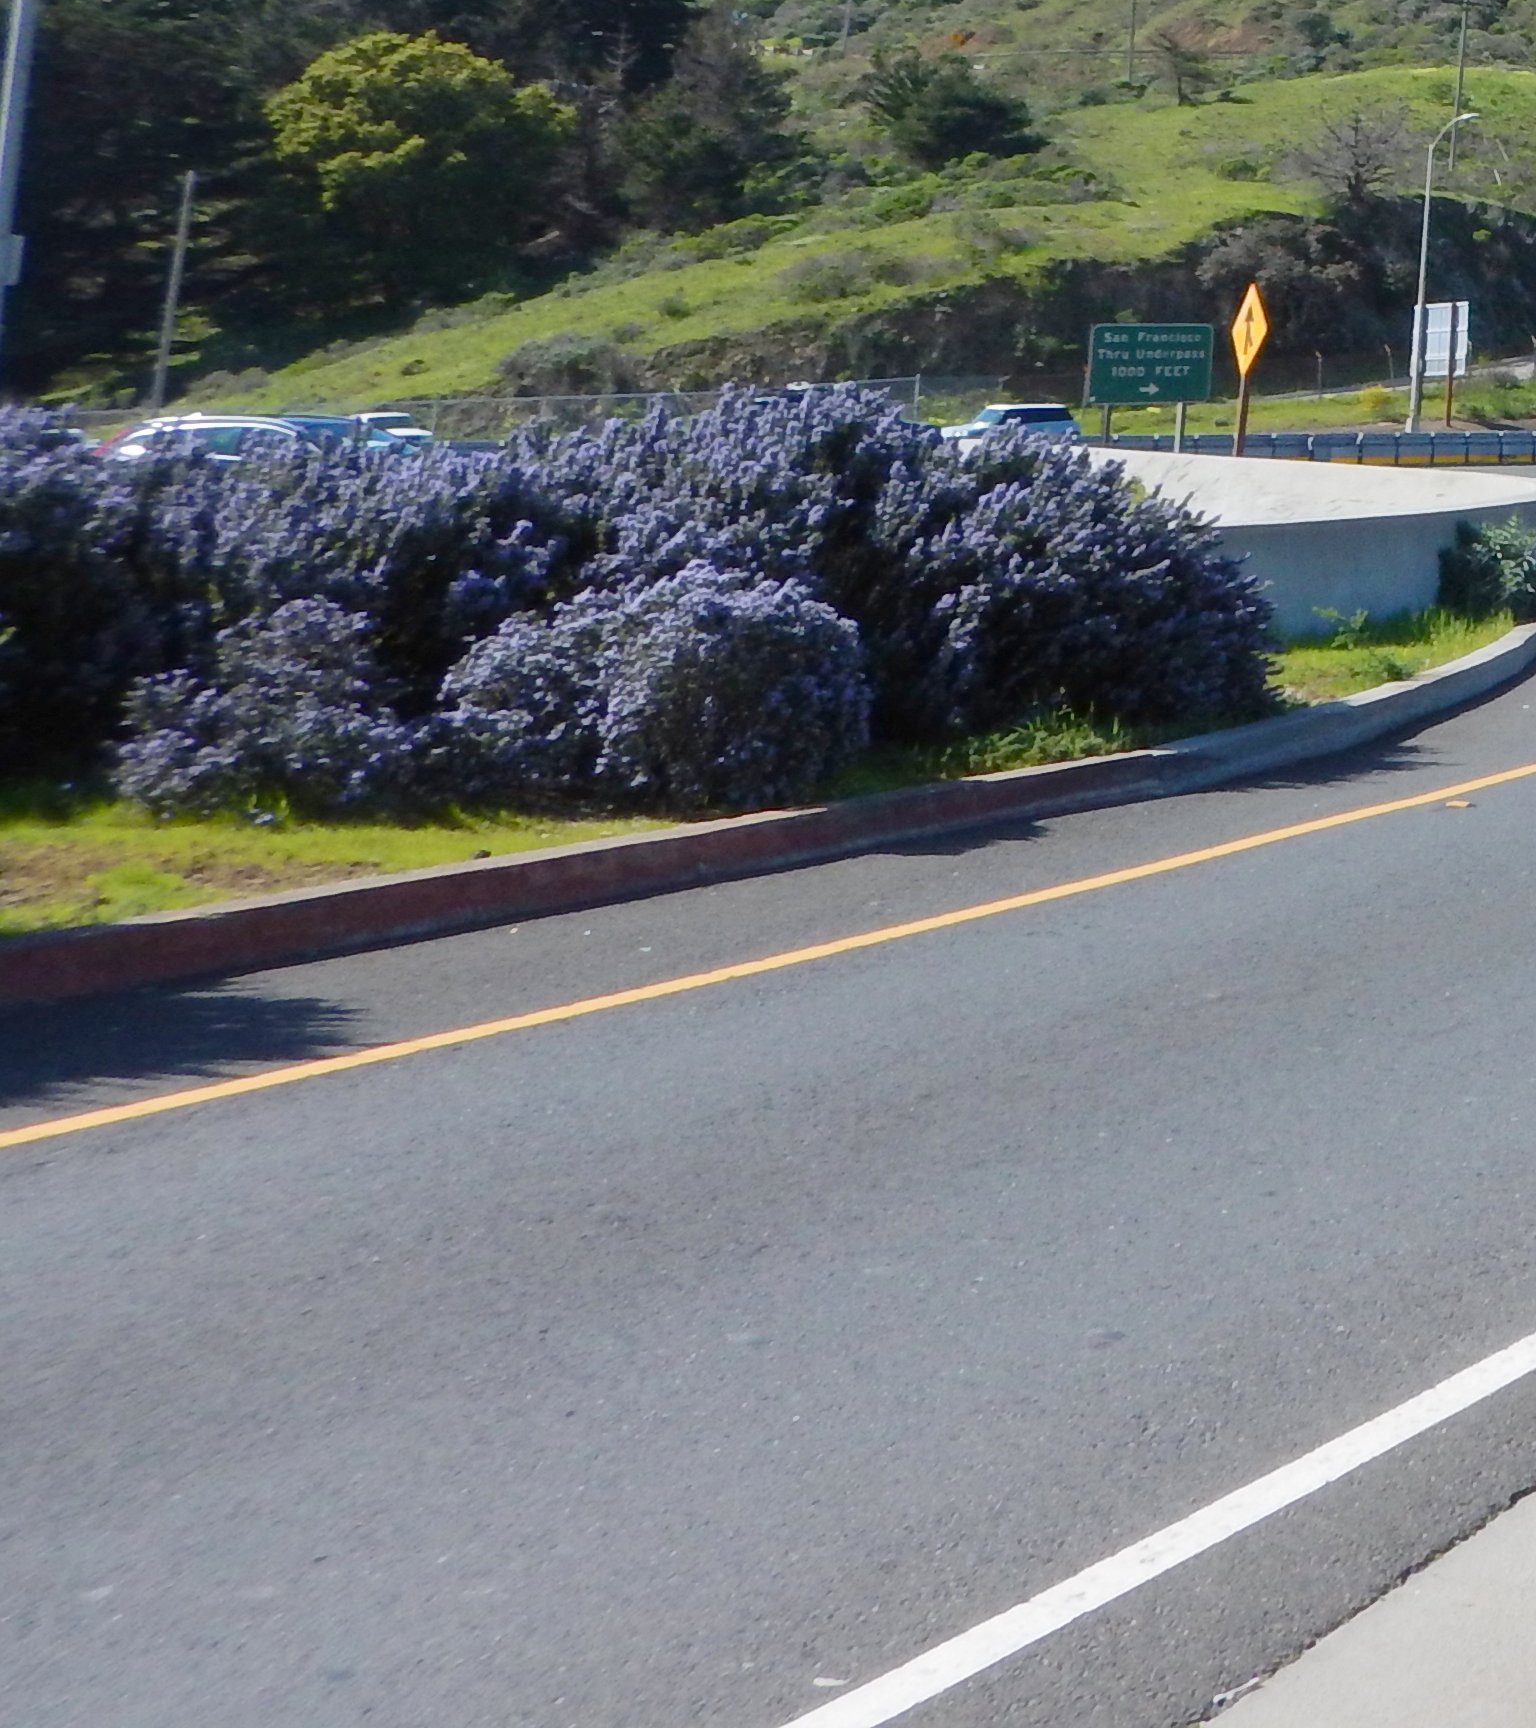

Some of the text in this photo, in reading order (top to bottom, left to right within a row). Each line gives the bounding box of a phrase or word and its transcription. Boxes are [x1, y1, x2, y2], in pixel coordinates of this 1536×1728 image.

[1104, 331, 1201, 343] San Francisco
[1097, 348, 1205, 360] Thru Underpass
[1111, 365, 1191, 377] 1000 FEET
